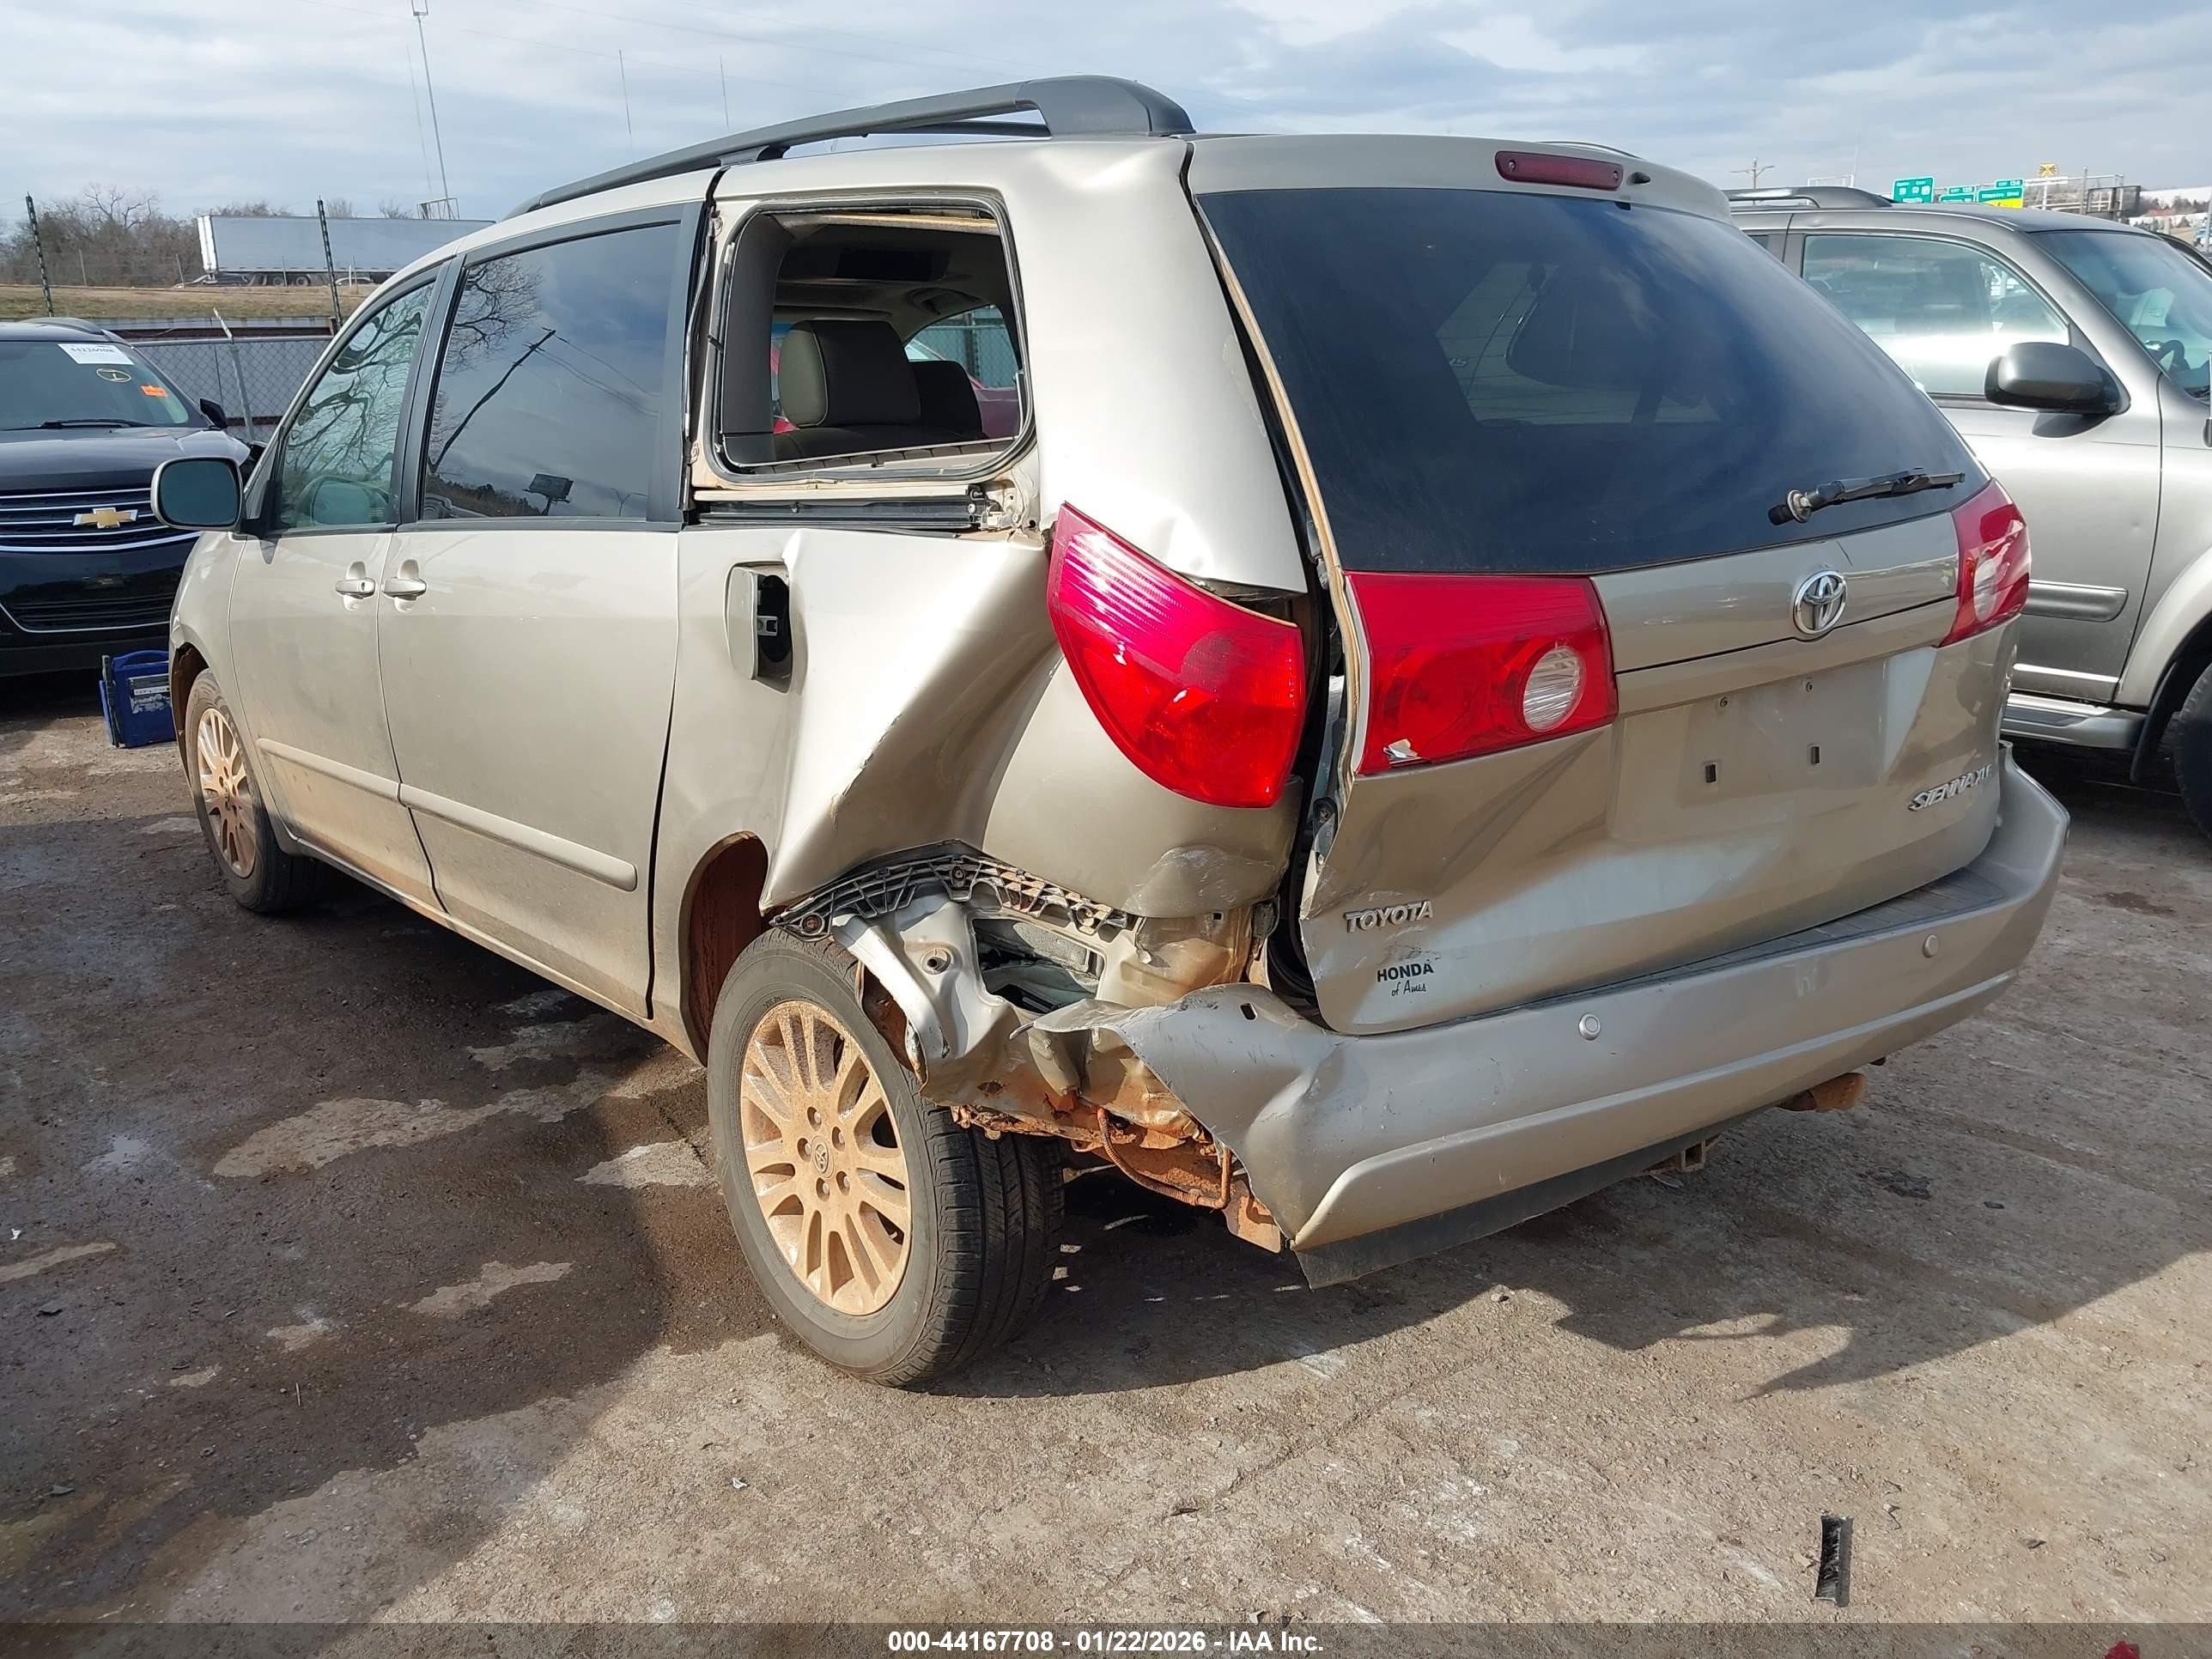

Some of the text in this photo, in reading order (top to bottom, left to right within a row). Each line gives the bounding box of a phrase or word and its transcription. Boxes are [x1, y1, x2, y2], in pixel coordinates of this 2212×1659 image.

[1908, 772, 1975, 811] SIENNA
[1344, 899, 1434, 933] TOYOTA
[1376, 962, 1435, 982] HONDA
[1391, 981, 1427, 997] of Ames
